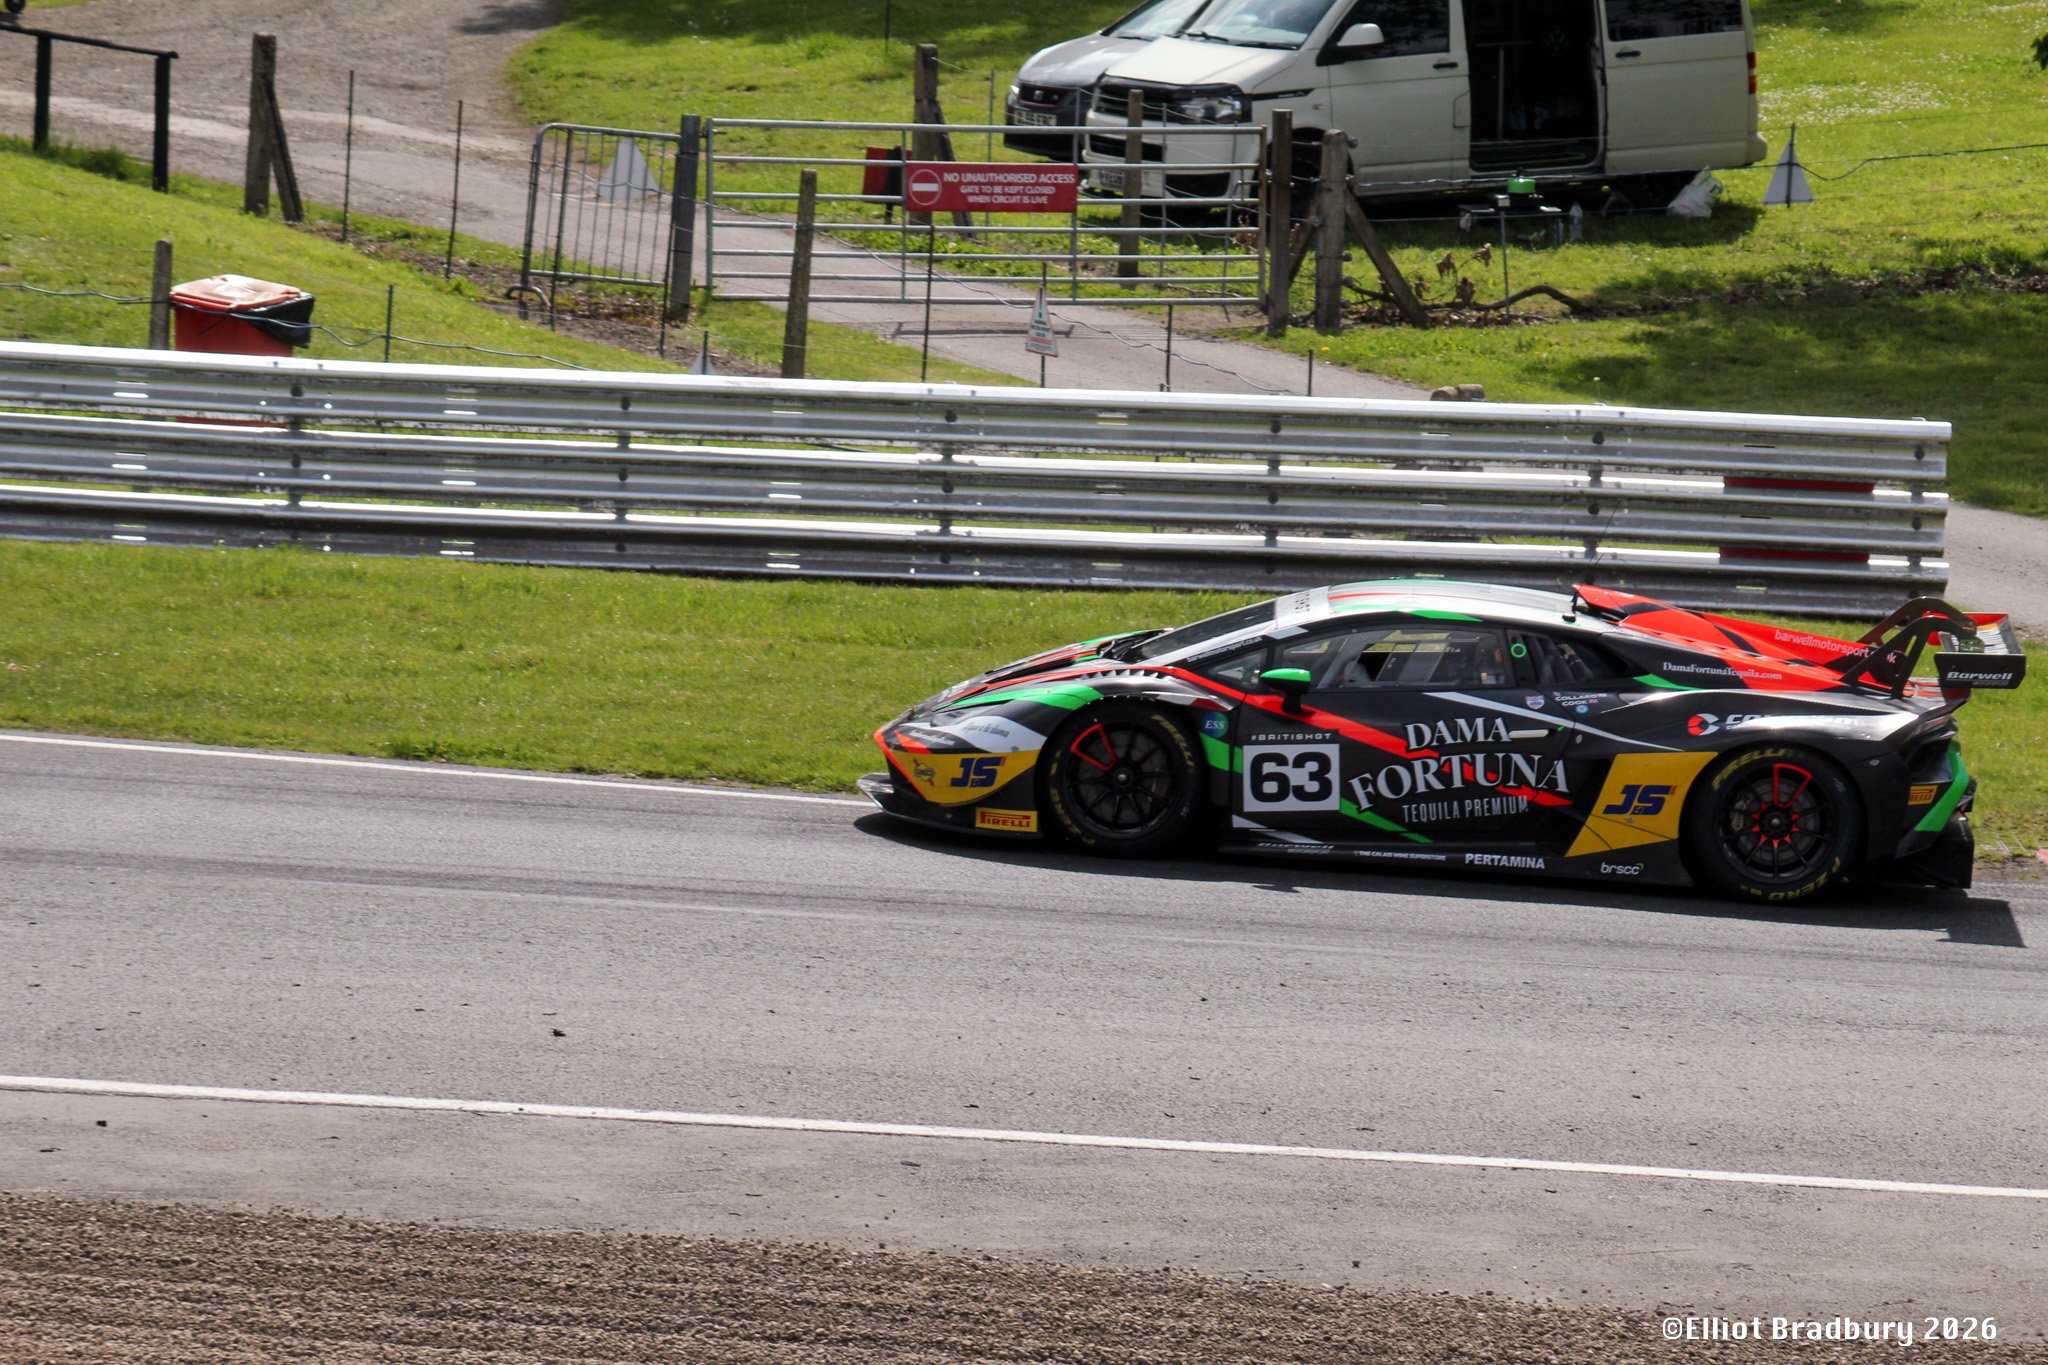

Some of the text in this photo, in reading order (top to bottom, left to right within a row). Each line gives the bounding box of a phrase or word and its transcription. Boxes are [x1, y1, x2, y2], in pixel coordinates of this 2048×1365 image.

[944, 173, 1075, 184] NO UNAUTHORISED ACCESS
[961, 186, 1057, 195] GATE TO BE KEPT CLOSED
[968, 195, 1048, 204] WHEN CIRCUIT IS LIVE
[1662, 661, 1783, 680] DamaFortunaTequila.com
[1946, 671, 2013, 681] Barwell
[1555, 694, 1598, 702] COLLARD
[1204, 720, 1225, 730] ESS
[1404, 717, 1512, 750] DAMA
[1151, 714, 1196, 767] PIRELLI
[1251, 733, 1332, 741] #BRITISHGT
[951, 757, 1004, 788] JS
[1250, 751, 1333, 803] 63
[1712, 748, 1792, 791] PIRELLI
[1347, 752, 1570, 811] FORTUNA
[1602, 784, 1673, 816] JS
[1402, 795, 1529, 823] TEQUILA PREMIUM
[980, 811, 1031, 828] PIRELLI
[1409, 853, 1446, 861] SUPERSTORE
[1464, 853, 1545, 870] PERTAMINA
[1601, 862, 1641, 876] brscc
